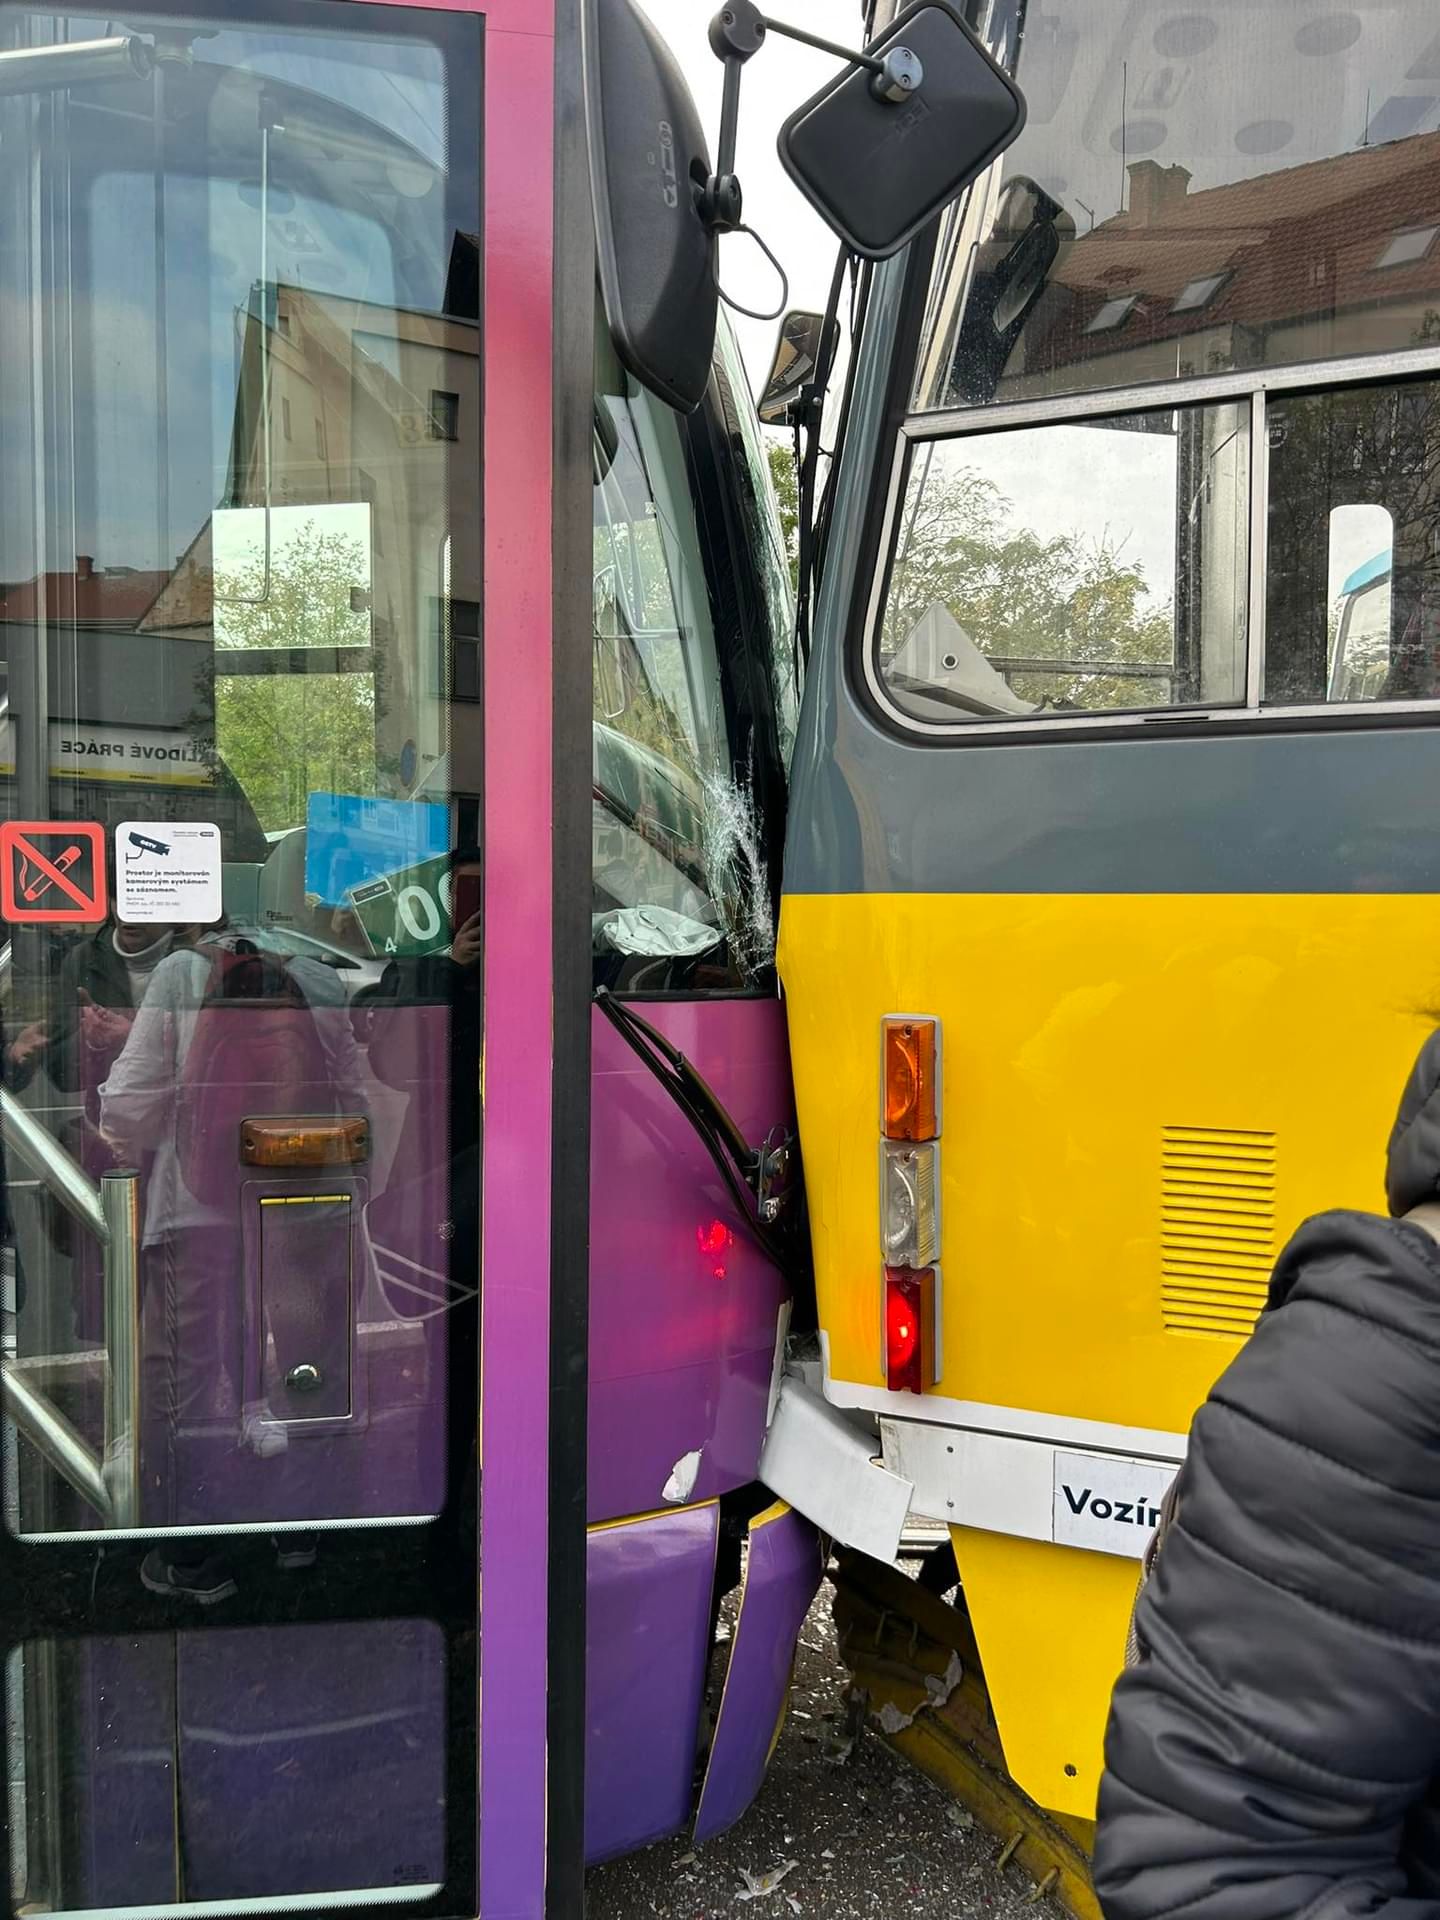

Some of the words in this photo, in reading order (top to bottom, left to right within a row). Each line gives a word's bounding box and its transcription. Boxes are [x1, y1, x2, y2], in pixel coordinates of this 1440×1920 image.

[154, 869, 161, 877] je
[126, 878, 169, 886] kamerovým
[171, 878, 208, 886] systémem
[385, 936, 397, 953] 4
